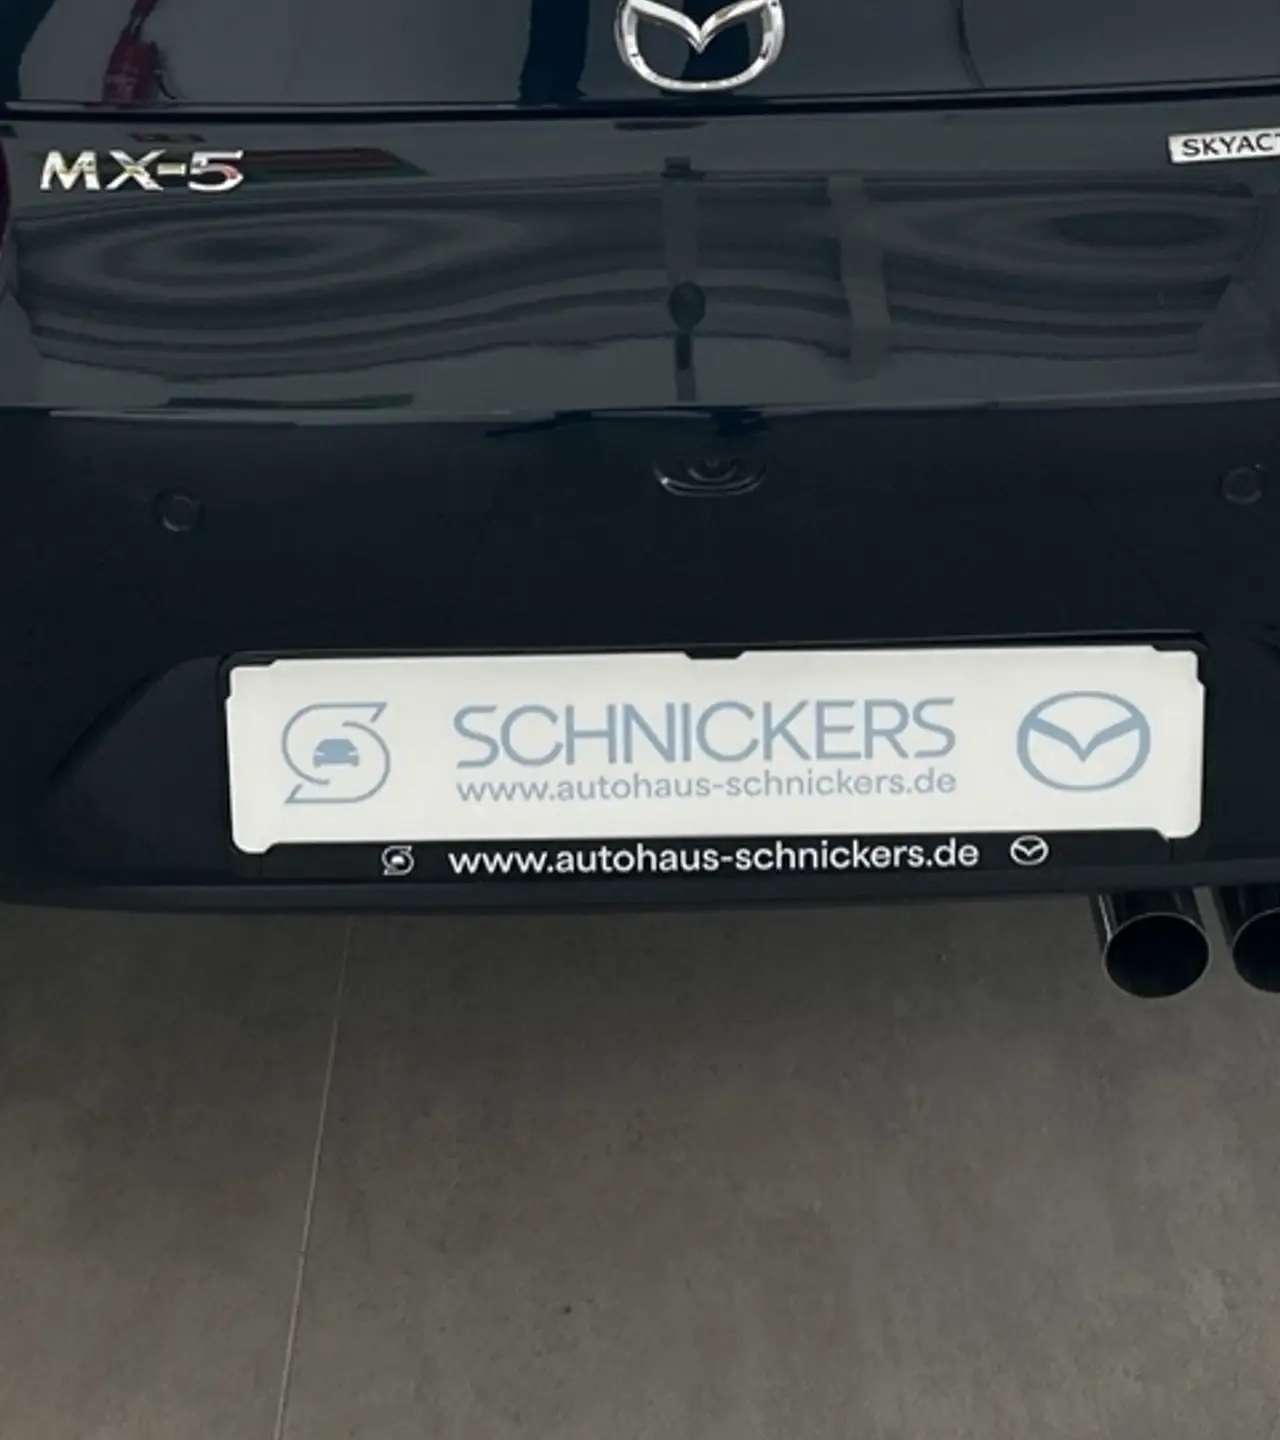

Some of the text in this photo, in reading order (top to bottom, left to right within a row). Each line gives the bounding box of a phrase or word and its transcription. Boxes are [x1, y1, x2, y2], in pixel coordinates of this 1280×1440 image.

[40, 149, 243, 192] MX-5
[453, 698, 956, 769] SCHNICKERS
[456, 768, 956, 802] www.autohaus-schnickers.de
[448, 838, 979, 874] www.autohaus-schnickers.de
